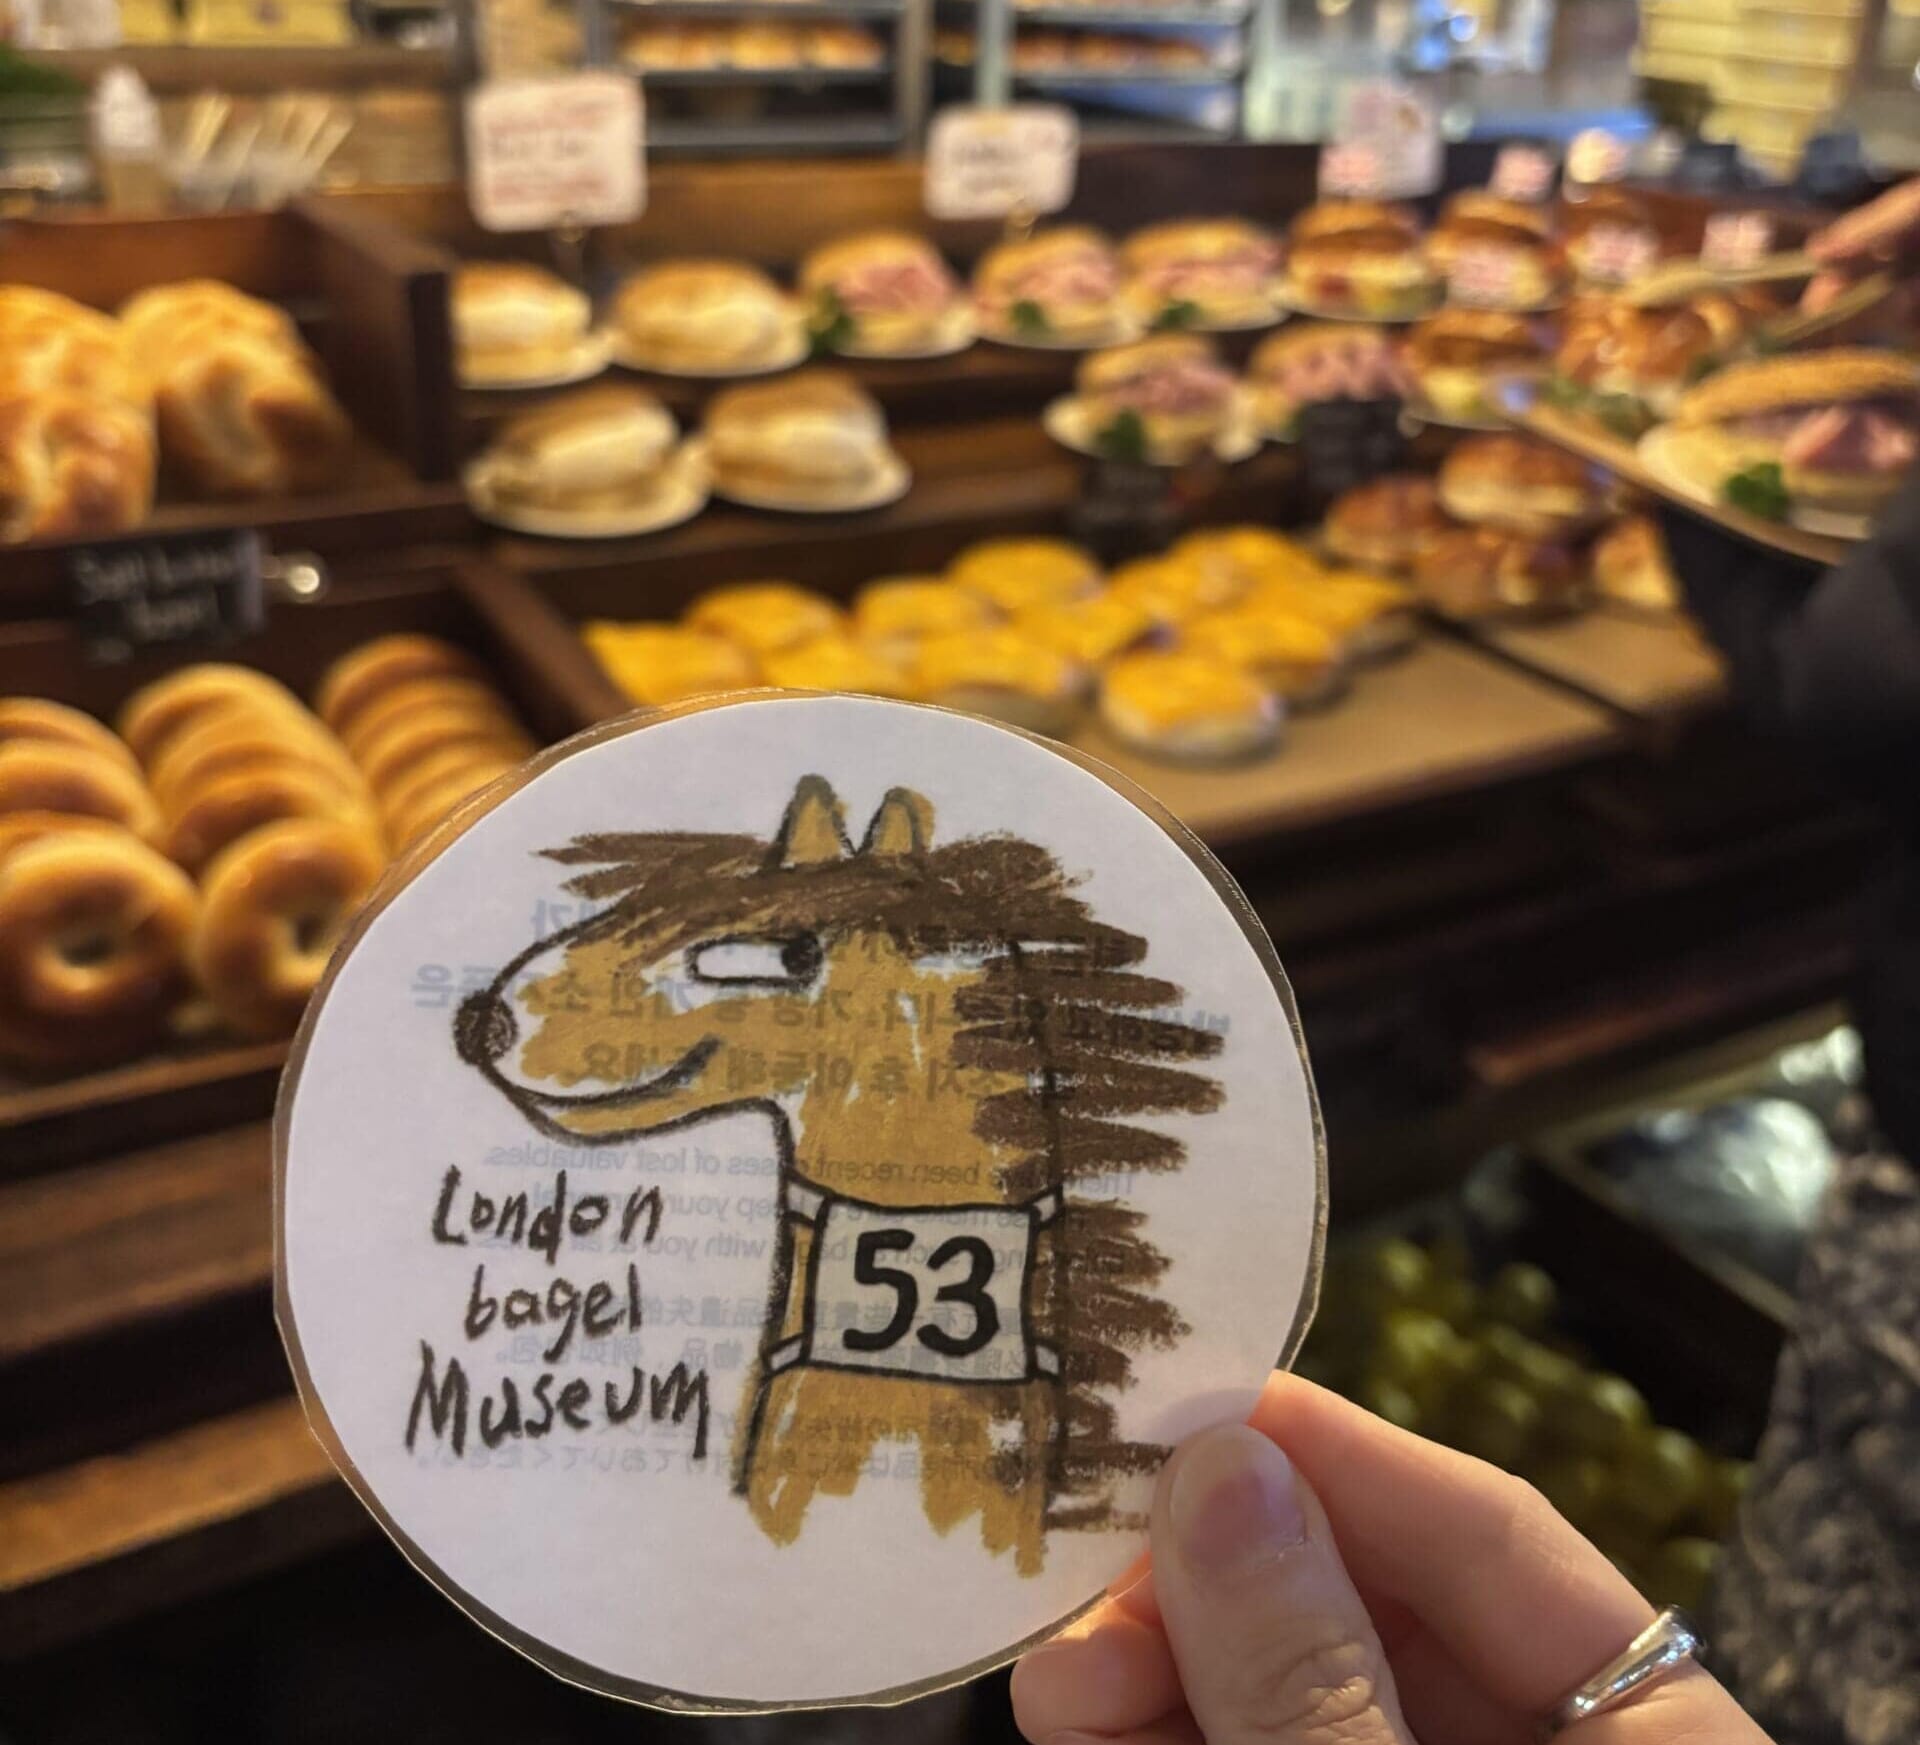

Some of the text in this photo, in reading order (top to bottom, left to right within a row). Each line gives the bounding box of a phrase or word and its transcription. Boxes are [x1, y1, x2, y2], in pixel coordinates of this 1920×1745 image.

[433, 1164, 662, 1265] London
[465, 1263, 642, 1363] bagel
[843, 1226, 999, 1358] 53
[405, 1339, 708, 1460] Museum
